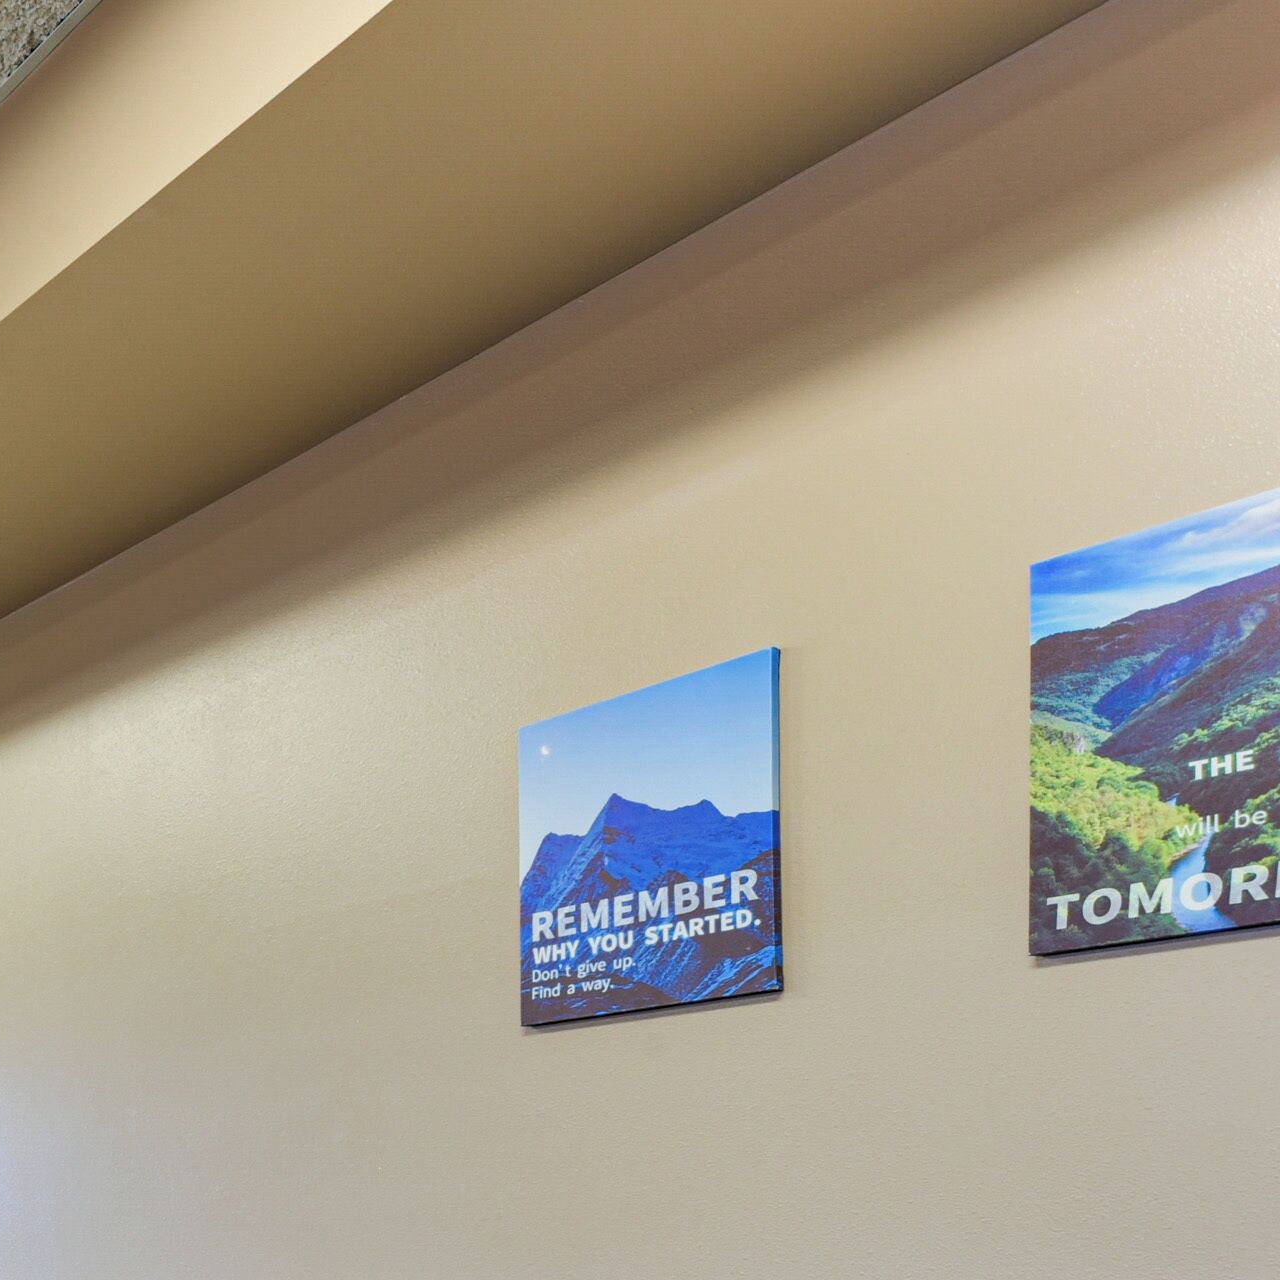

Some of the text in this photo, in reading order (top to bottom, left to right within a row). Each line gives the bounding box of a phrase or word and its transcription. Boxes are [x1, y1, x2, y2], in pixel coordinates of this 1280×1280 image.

[1188, 750, 1255, 781] THE
[1175, 809, 1268, 838] will be
[532, 868, 759, 943] REMEMBER
[1046, 863, 1280, 931] TOMOR
[533, 908, 762, 964] WHY YOU STARTED.
[577, 960, 606, 978] give
[613, 956, 637, 971] up.
[532, 978, 615, 1000] Find a way.
